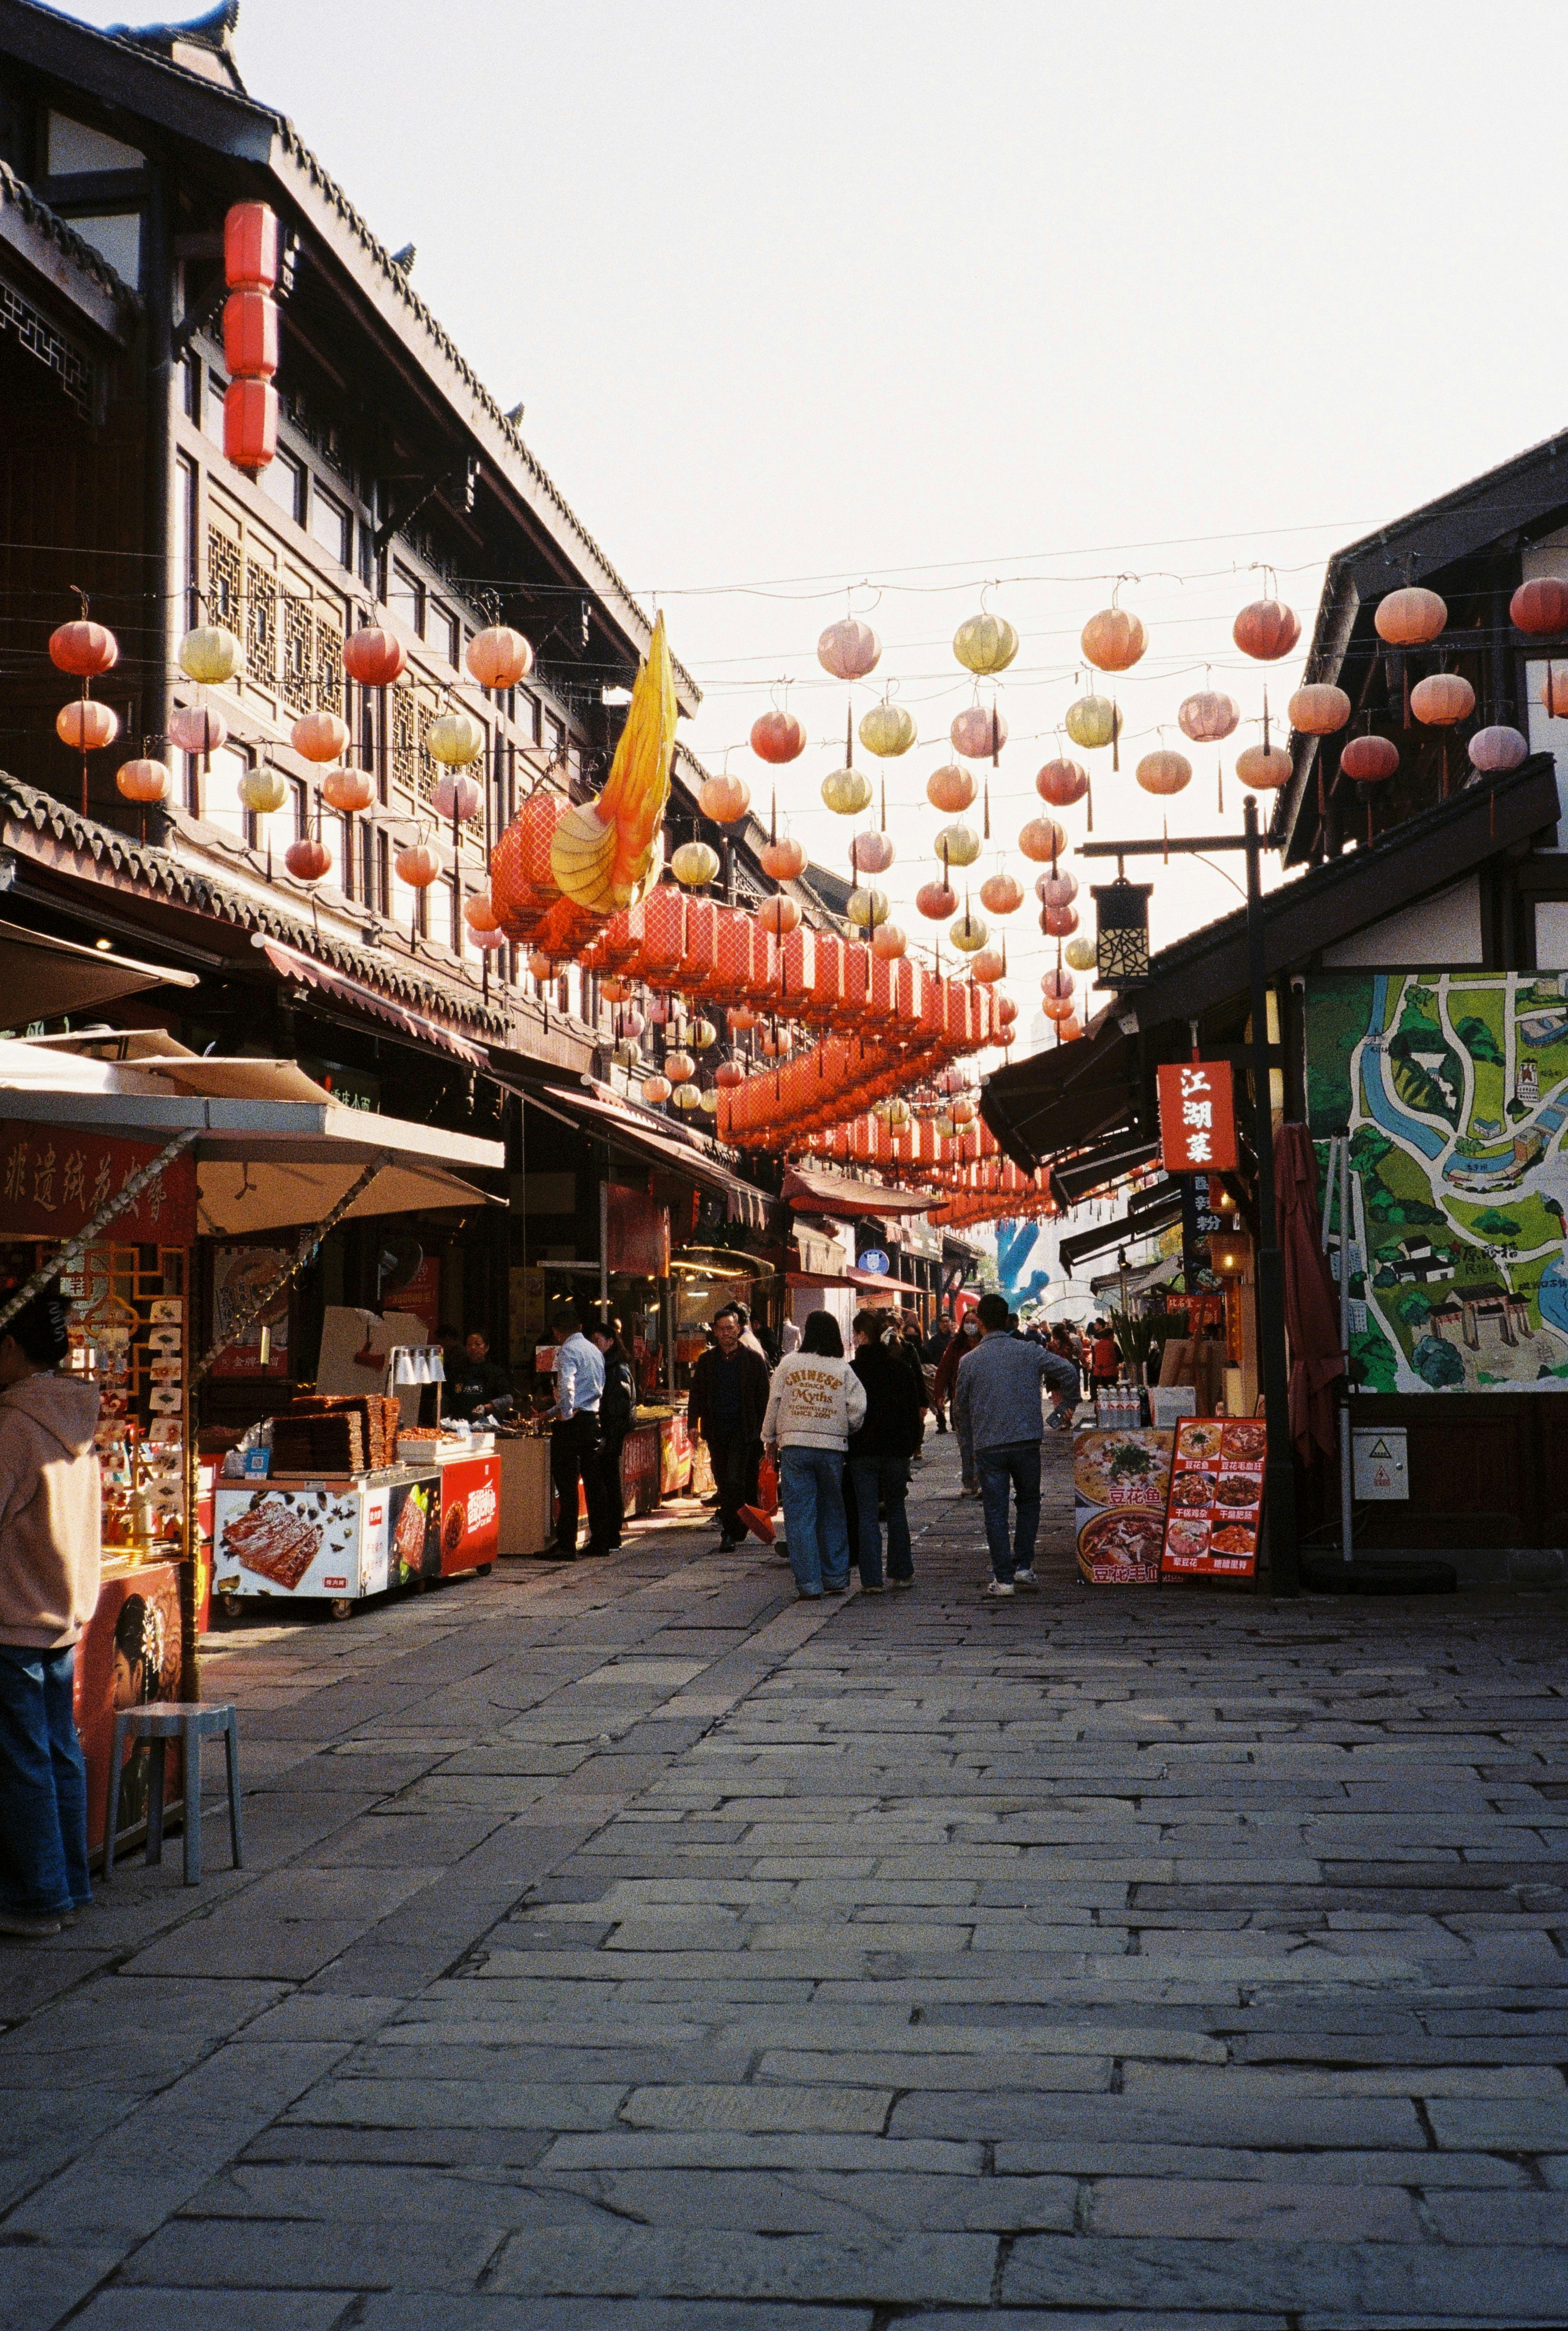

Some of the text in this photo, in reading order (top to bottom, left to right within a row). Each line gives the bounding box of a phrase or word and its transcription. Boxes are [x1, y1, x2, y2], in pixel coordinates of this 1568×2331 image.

[1181, 1068, 1213, 1163] 江湖菜
[785, 1370, 842, 1390] CHINESE
[791, 1388, 833, 1405] Myths
[1185, 1461, 1209, 1469] 豆花鱼
[1221, 1461, 1263, 1470] 豆花毛血旺
[1109, 1487, 1162, 1504] 豆花鱼
[1176, 1508, 1208, 1518] 干锅鸡杂
